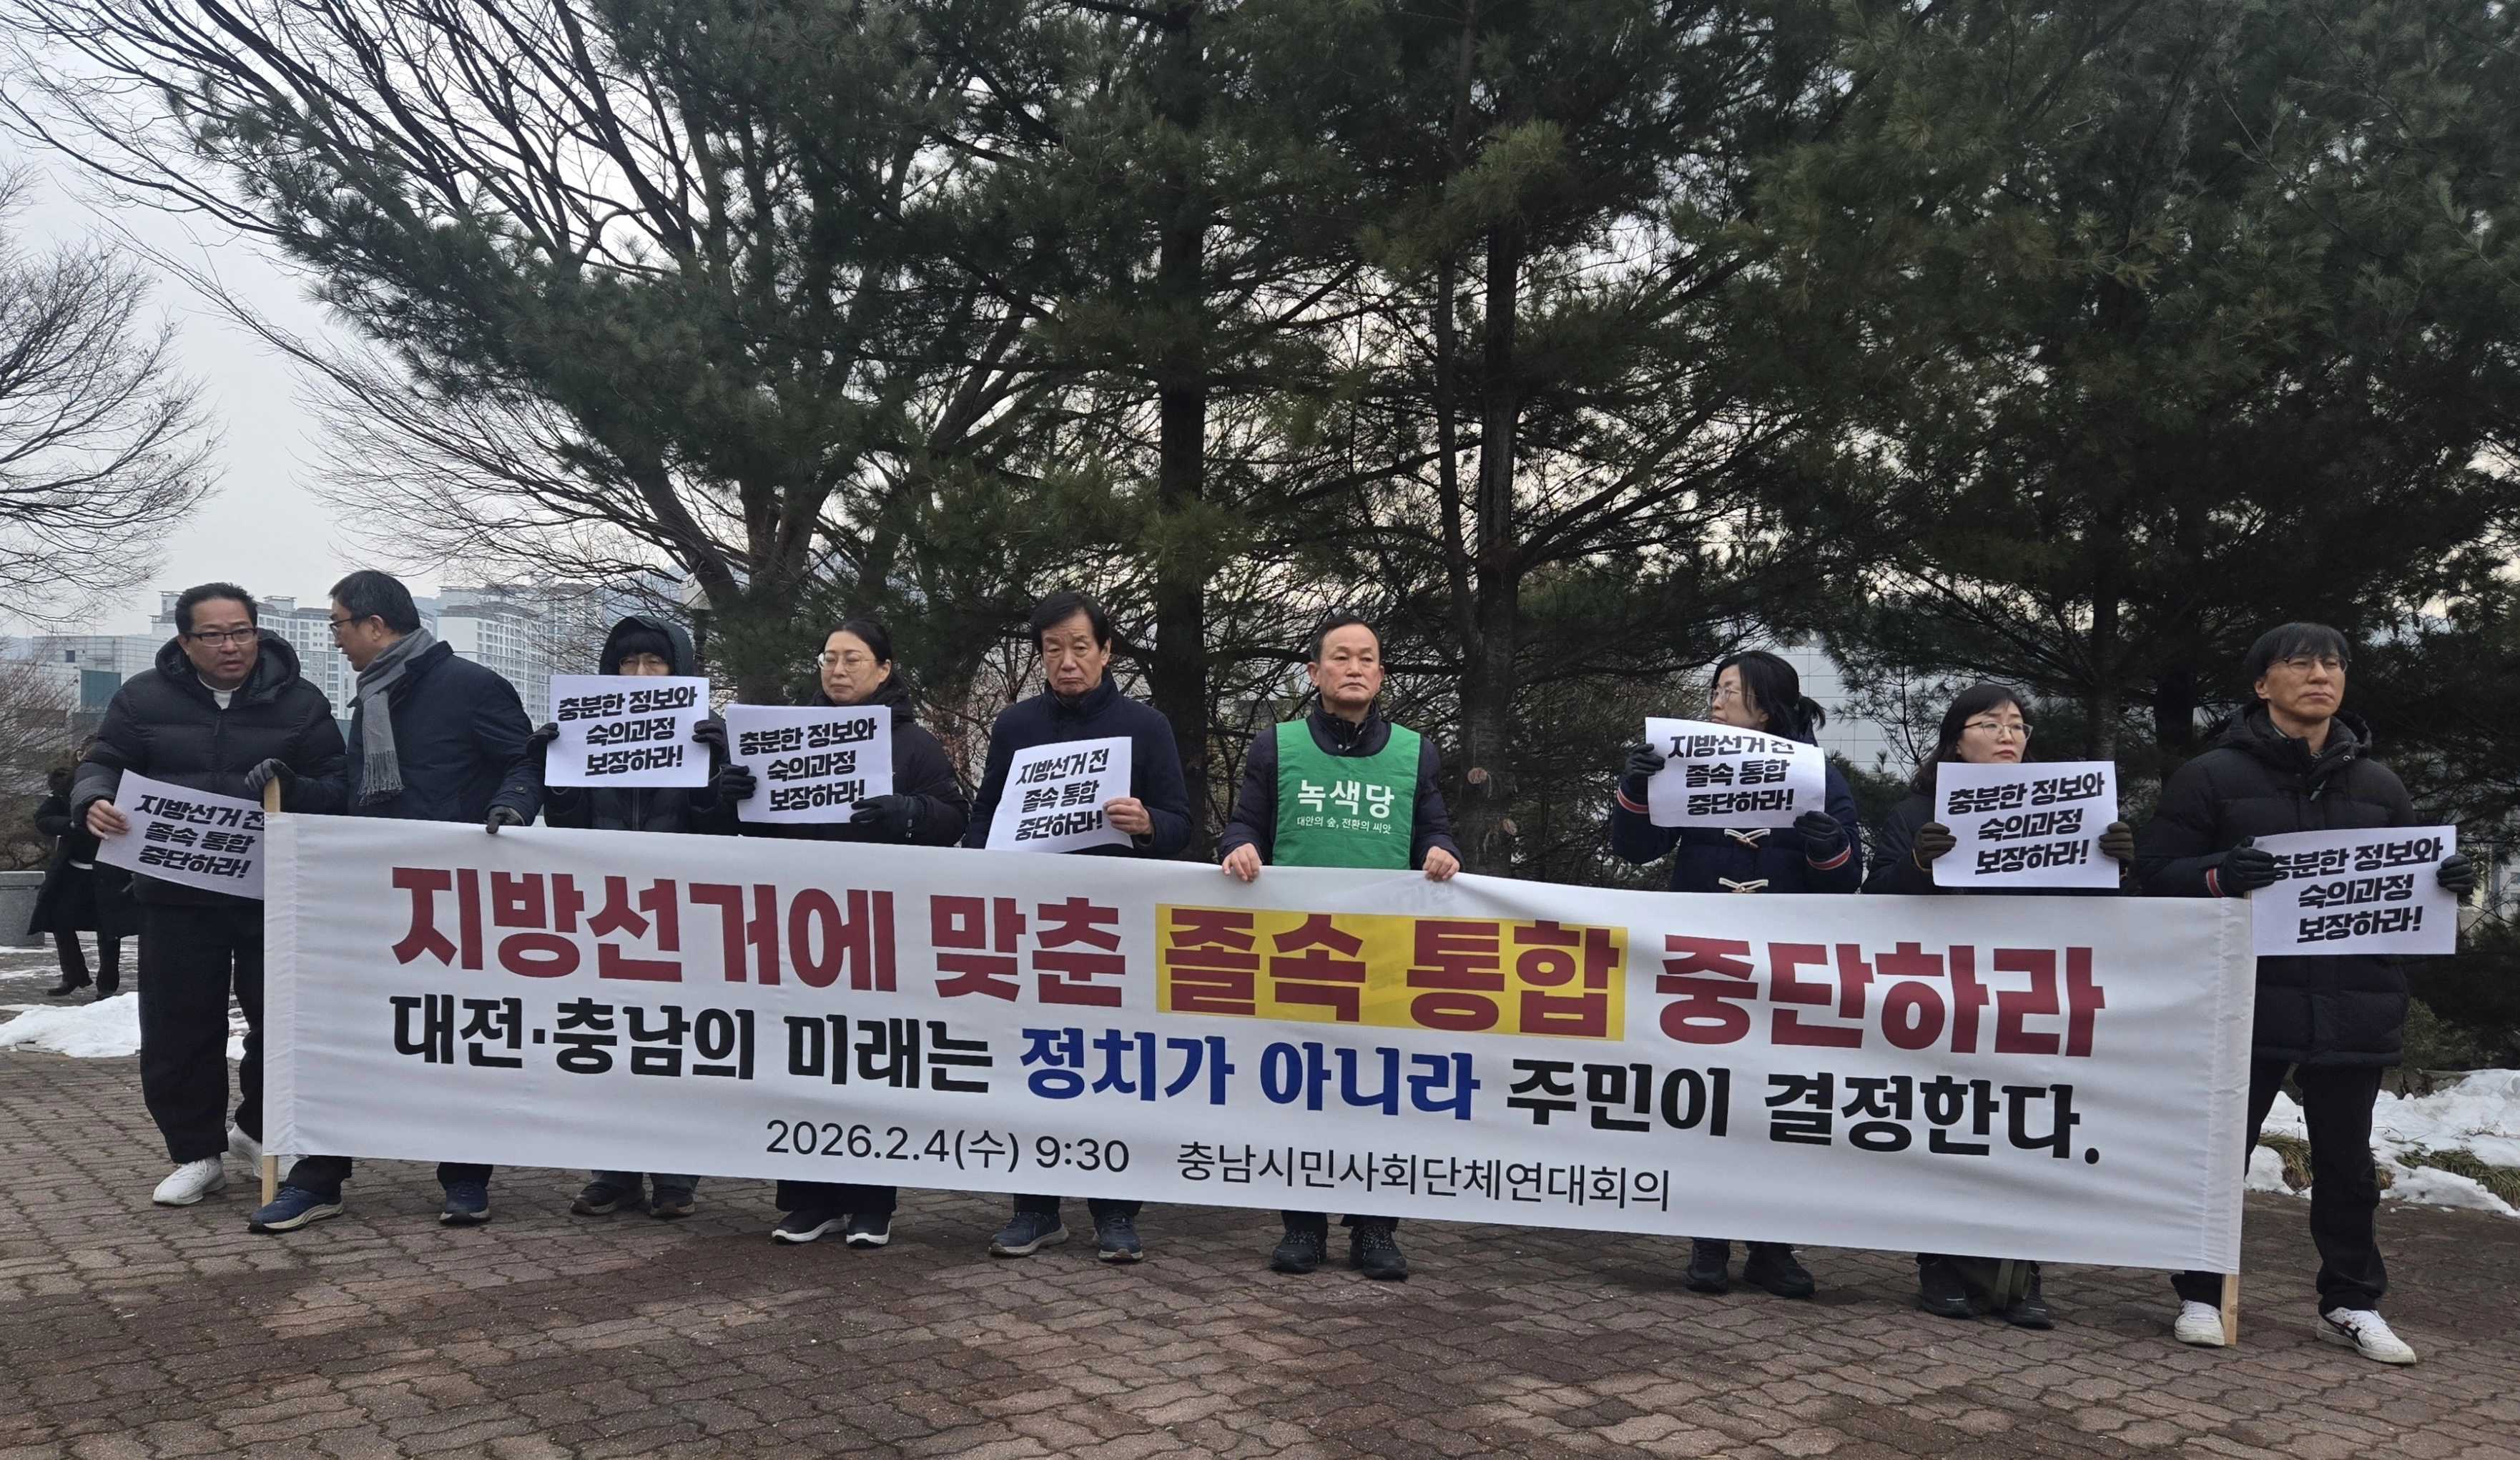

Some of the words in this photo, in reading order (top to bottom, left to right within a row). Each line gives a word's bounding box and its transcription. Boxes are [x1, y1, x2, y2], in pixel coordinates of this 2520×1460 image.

[558, 693, 626, 721] 충분한
[629, 686, 698, 714] 정보와
[586, 716, 676, 746] 숙의과정
[739, 726, 804, 756] 충분한
[807, 717, 877, 749] 정보와
[1668, 734, 1766, 759] 지방선거
[584, 745, 684, 776] 보장하라!
[767, 750, 856, 782] 숙의과정
[1015, 751, 1088, 786] 지방선거
[1088, 747, 1110, 774] 전
[1685, 762, 1734, 788] 졸속
[1739, 759, 1791, 785] 통합
[769, 779, 865, 812] 보장하라!
[1021, 786, 1059, 814] 졸속
[1060, 779, 1100, 807] 통합
[1297, 779, 1395, 819] 녹색당
[1687, 788, 1794, 816] 중단하라!
[1947, 782, 2027, 815] 충분한
[2031, 771, 2105, 807] 정보와
[134, 794, 242, 827] 지방선거
[1015, 809, 1103, 842] 중단하라!
[1296, 816, 1324, 827] 대안의
[1327, 817, 1339, 829] 숲,
[1341, 818, 1369, 832] 전환의
[1372, 822, 1392, 835] 씨앗
[1978, 808, 2084, 842] 숙의과정
[144, 821, 198, 847] 졸속
[200, 830, 255, 854] 통합
[2354, 837, 2443, 872] 정보와
[138, 845, 252, 879] 중단하라!
[1974, 839, 2090, 875] 보장하라!
[2298, 873, 2415, 909] 숙의과정
[2296, 905, 2423, 944] 보장하라!
[390, 866, 897, 992] 지방선거에
[930, 894, 1126, 1008] 맞춘
[1165, 907, 1366, 1022] 졸속
[1406, 919, 1620, 1038] 통합
[1655, 933, 2106, 1057] 중단하라
[389, 994, 755, 1080] 대전·충남의
[783, 1014, 993, 1093] 미래는
[1020, 1027, 1234, 1106] 정치가
[1259, 1036, 1481, 1121] 아니라
[1506, 1058, 1731, 1137] 주민이
[1765, 1071, 2100, 1165] 결정한다.
[767, 1119, 1020, 1175] 2026.2.4(수)
[1034, 1133, 1130, 1173] 9:30
[1177, 1140, 1670, 1212] 충남시민사회단체연대회의
